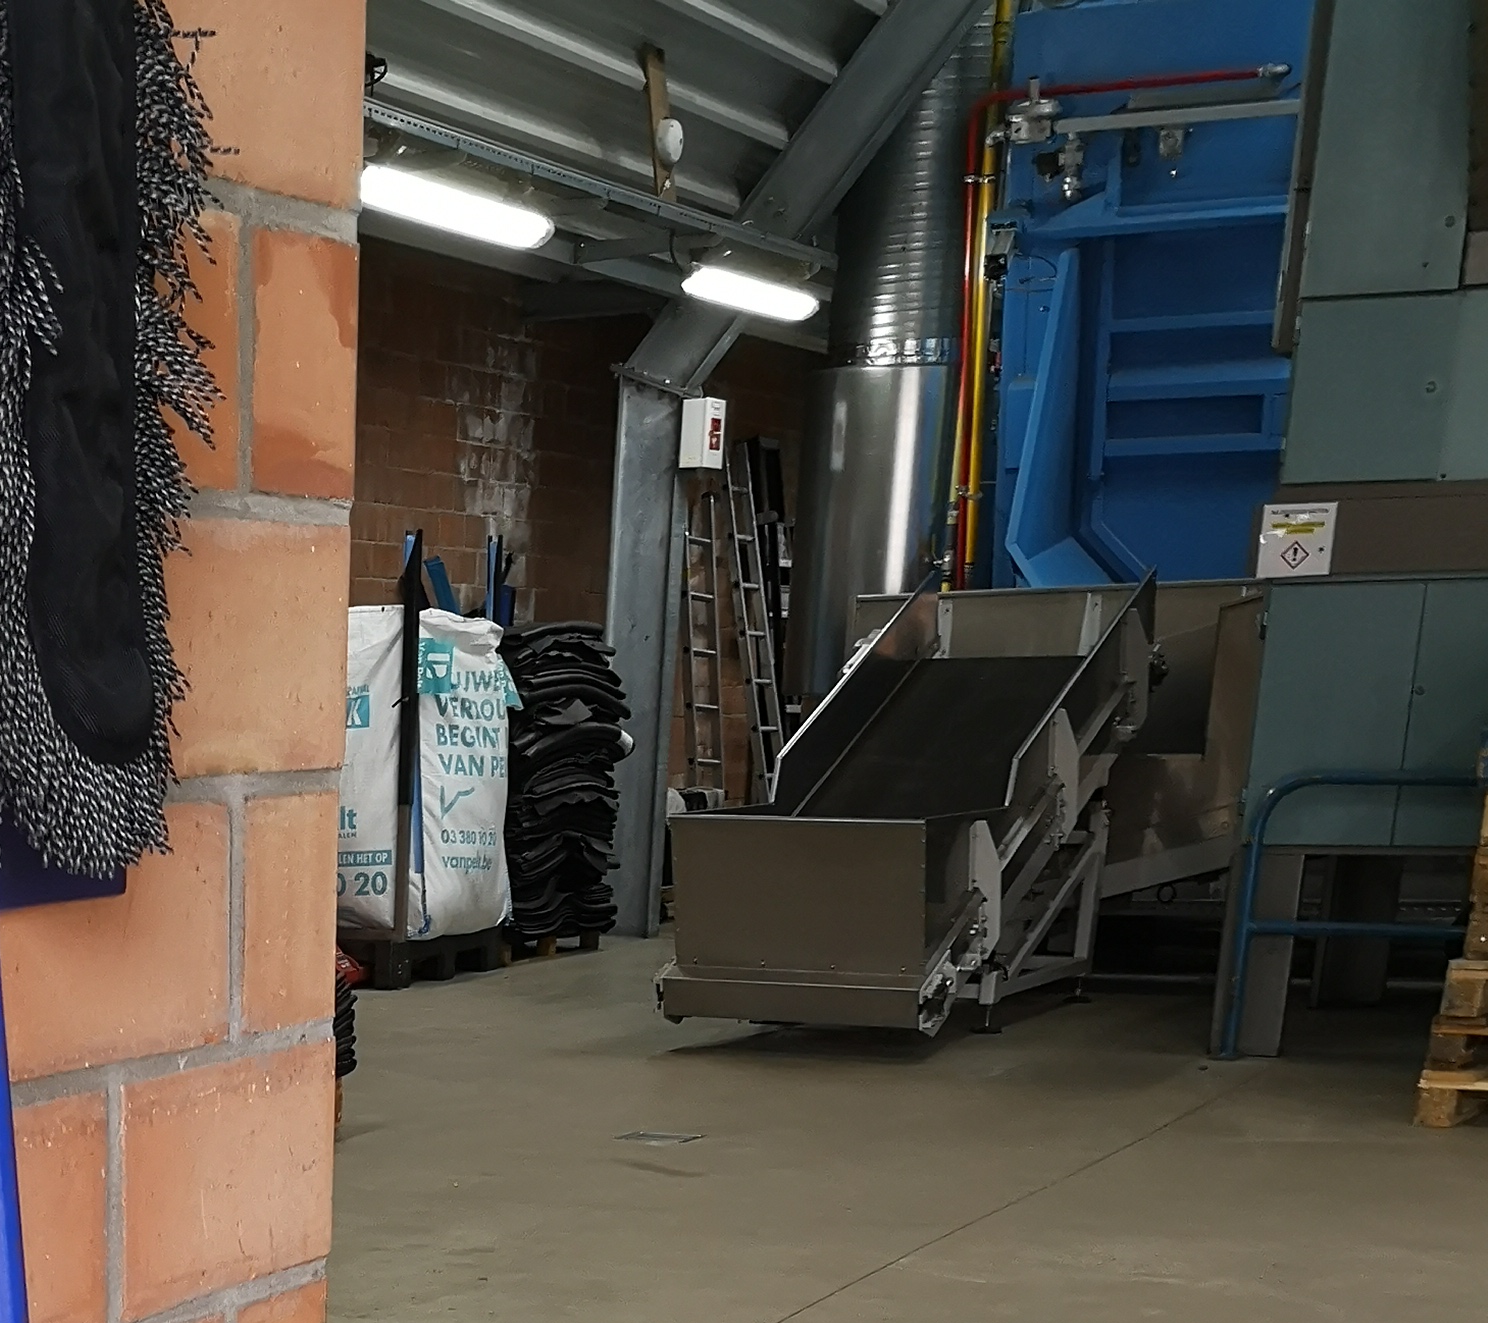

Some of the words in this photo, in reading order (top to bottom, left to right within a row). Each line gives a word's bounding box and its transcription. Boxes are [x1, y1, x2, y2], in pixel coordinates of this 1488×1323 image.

[438, 753, 485, 777] VAN
[491, 755, 507, 778] PE
[340, 806, 357, 830] lt
[441, 829, 457, 844] 03
[356, 853, 372, 864] HET
[375, 852, 388, 863] OP
[354, 871, 388, 896] 20
